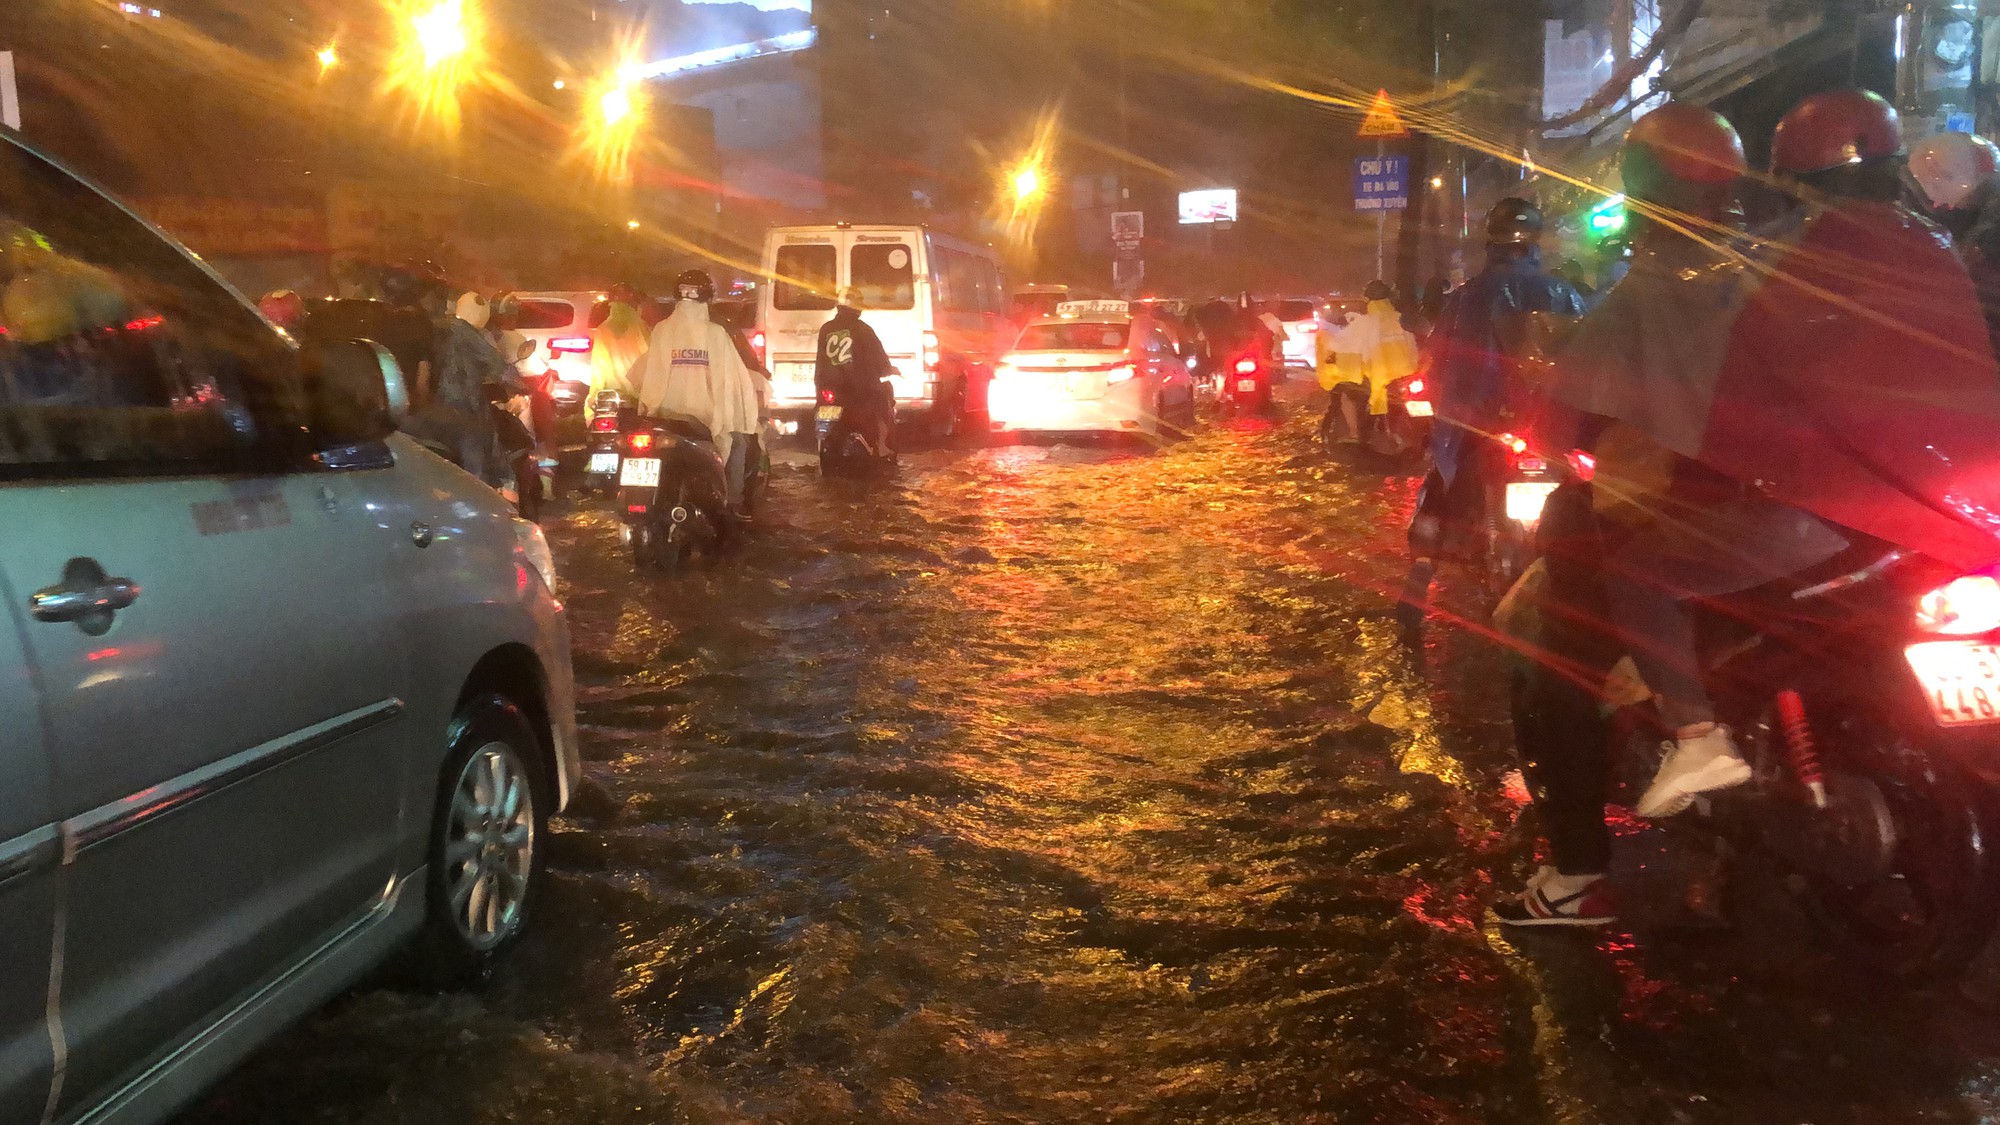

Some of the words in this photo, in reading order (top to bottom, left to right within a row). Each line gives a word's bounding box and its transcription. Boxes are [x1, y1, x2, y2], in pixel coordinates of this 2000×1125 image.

[1362, 181, 1373, 193] XE
[1374, 181, 1385, 192] RA
[1102, 303, 1113, 311] 27
[1115, 303, 1127, 311] 27
[826, 334, 853, 362] C2
